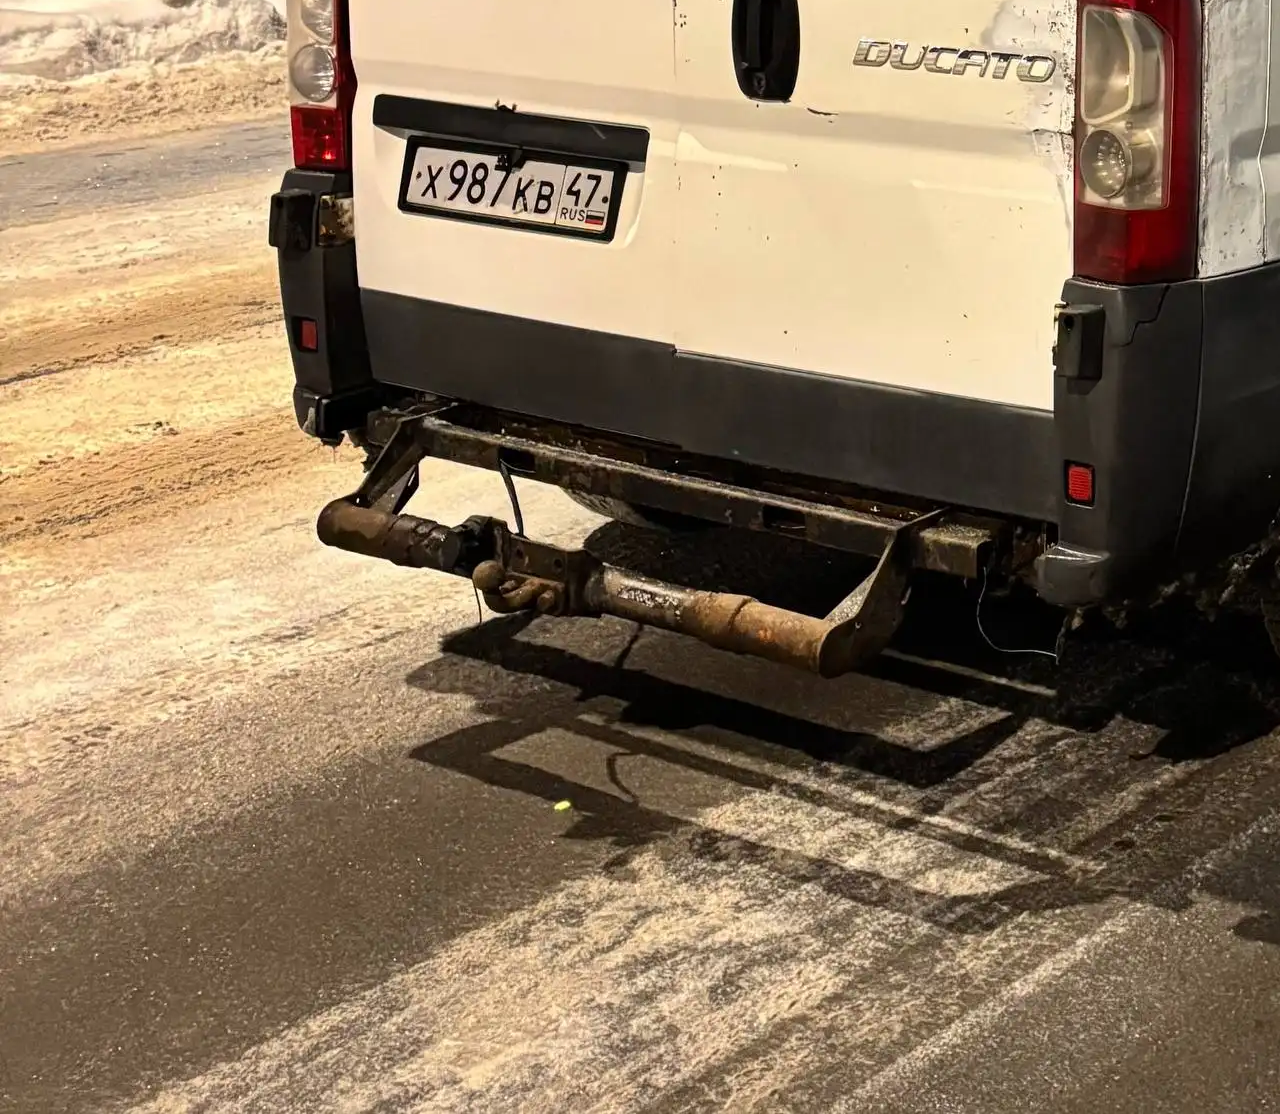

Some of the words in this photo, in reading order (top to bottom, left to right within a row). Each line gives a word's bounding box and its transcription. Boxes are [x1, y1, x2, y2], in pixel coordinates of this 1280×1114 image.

[852, 39, 1057, 83] DUCATO
[566, 172, 602, 208] 47
[560, 207, 585, 221] RUS
